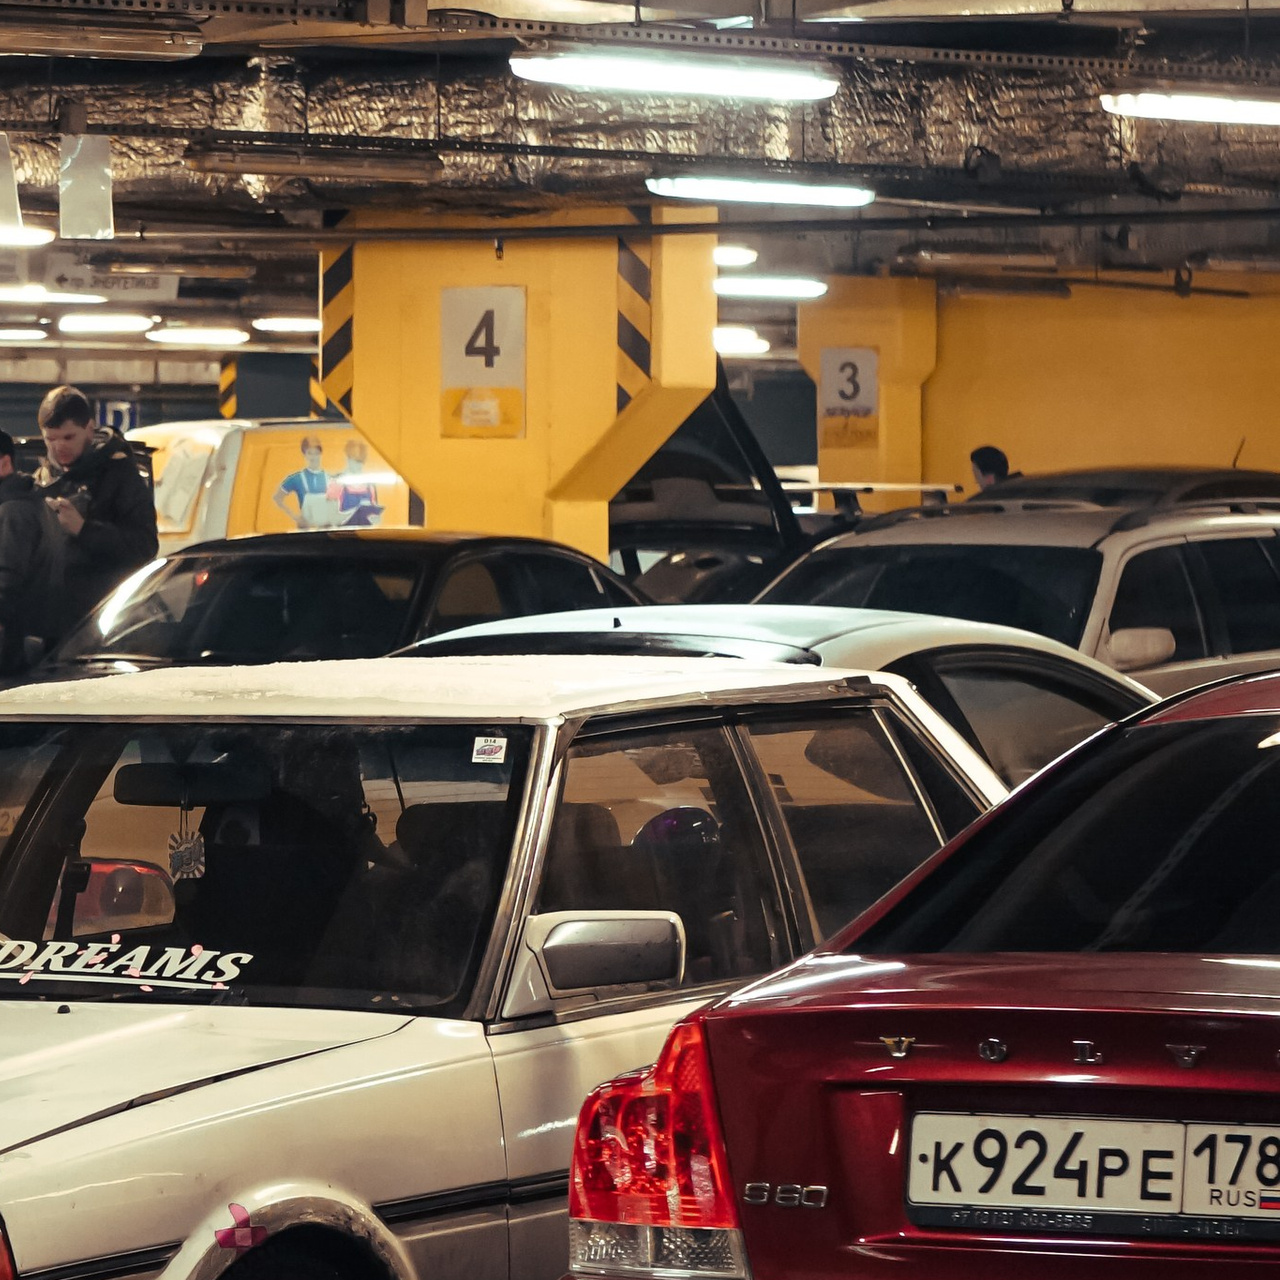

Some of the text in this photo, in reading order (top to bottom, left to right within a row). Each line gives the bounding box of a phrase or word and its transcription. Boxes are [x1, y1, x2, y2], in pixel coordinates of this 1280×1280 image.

[464, 308, 501, 369] 4
[838, 361, 861, 401] 3
[879, 1035, 1280, 1069] VOLV
[1193, 1133, 1280, 1187] 178
[1209, 1188, 1257, 1208] RUS
